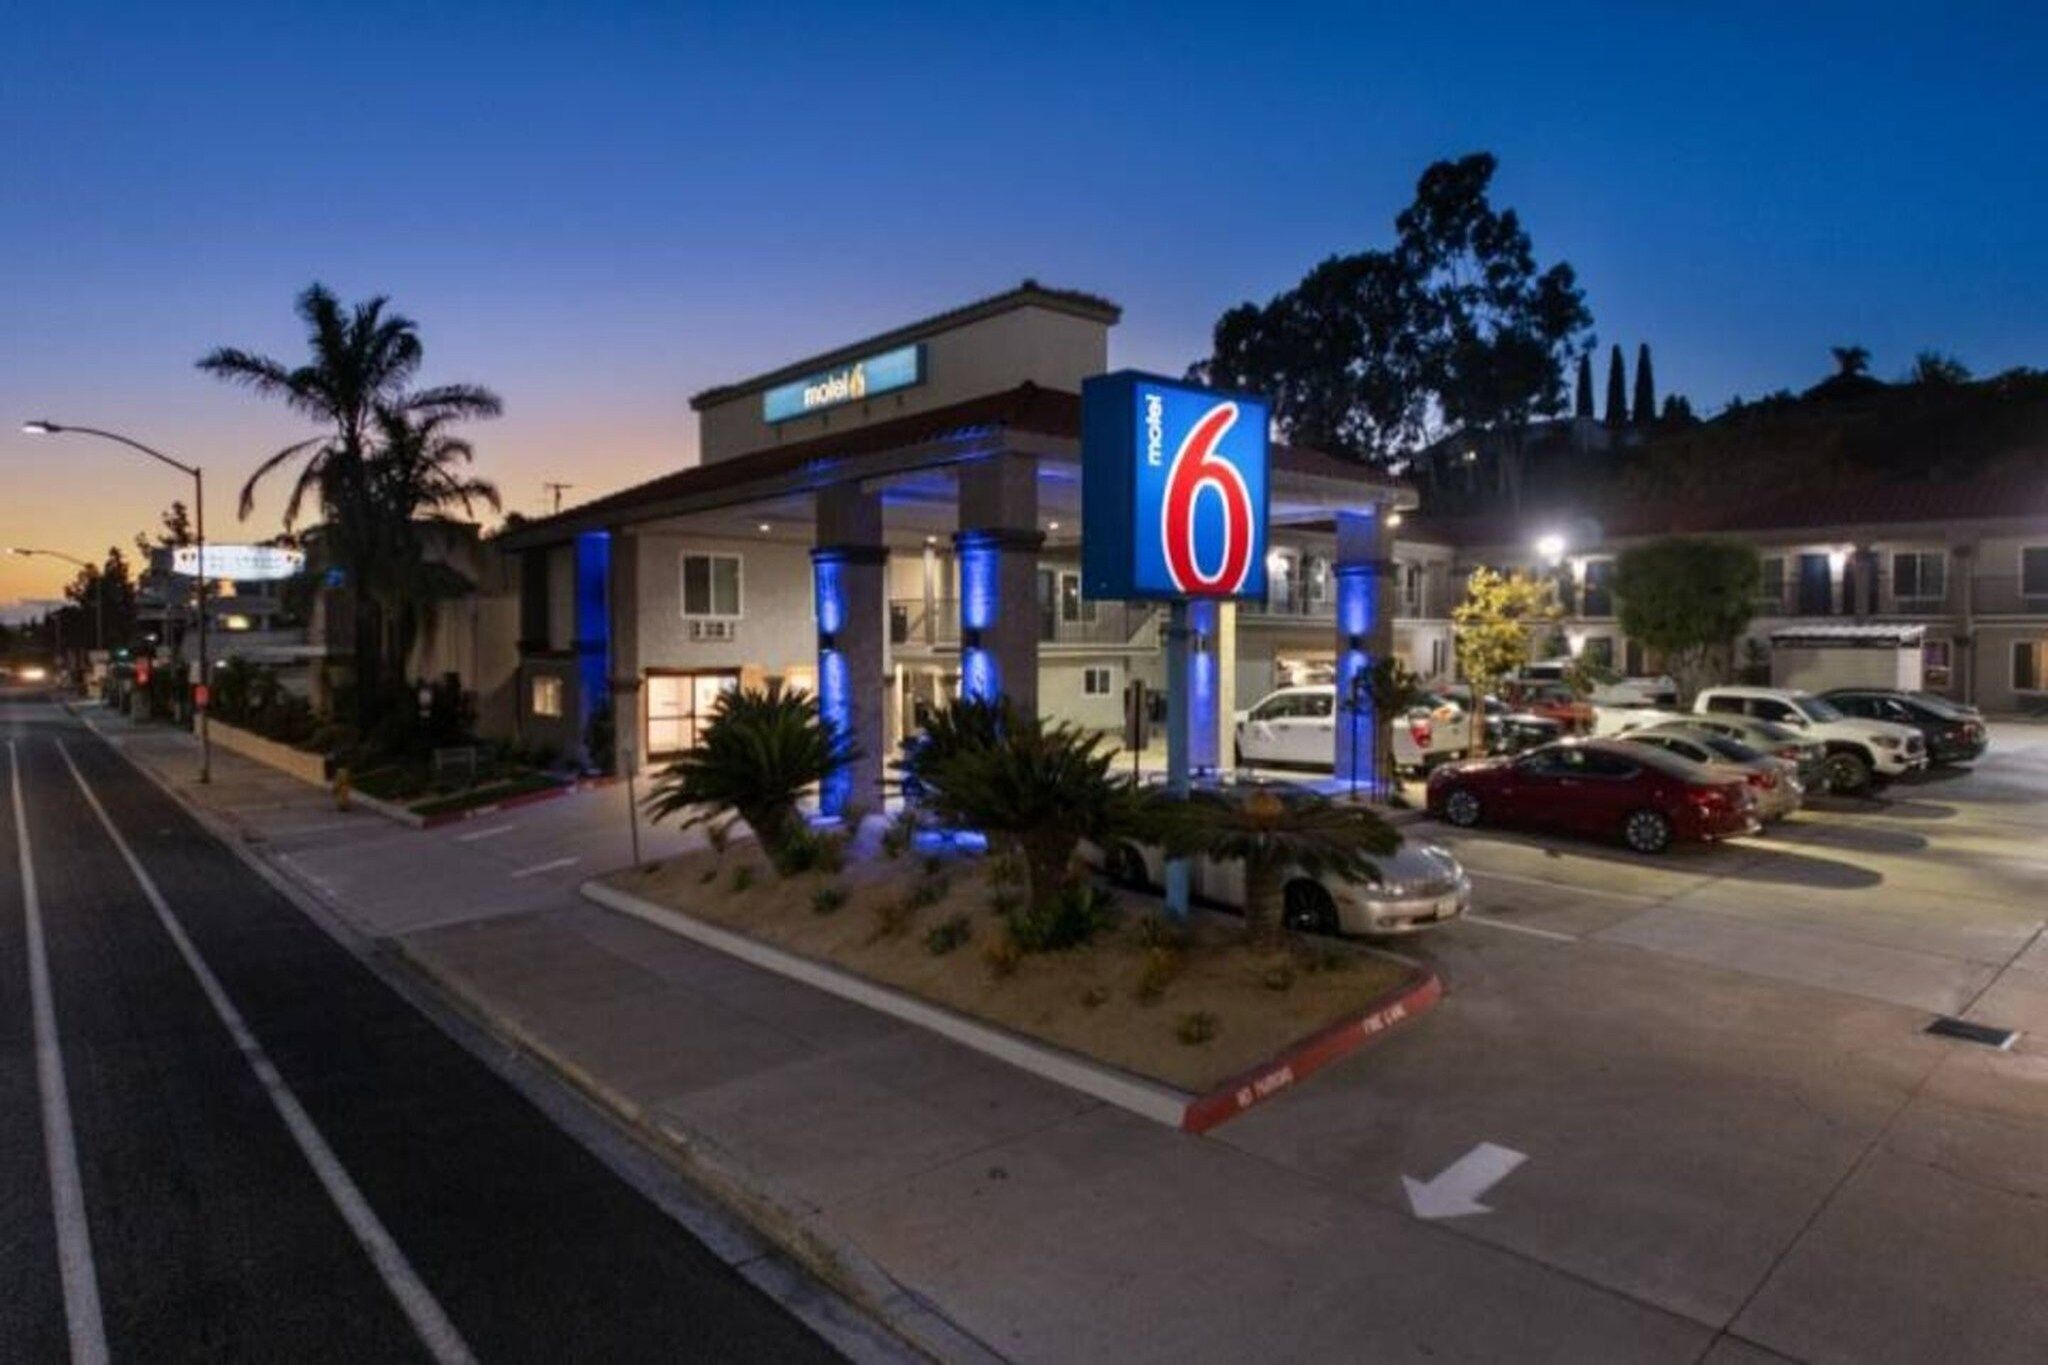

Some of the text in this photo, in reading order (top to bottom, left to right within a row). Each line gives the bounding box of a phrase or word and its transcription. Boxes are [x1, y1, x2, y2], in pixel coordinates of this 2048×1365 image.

[804, 362, 866, 409] motel 6
[1145, 394, 1255, 596] motel 6
